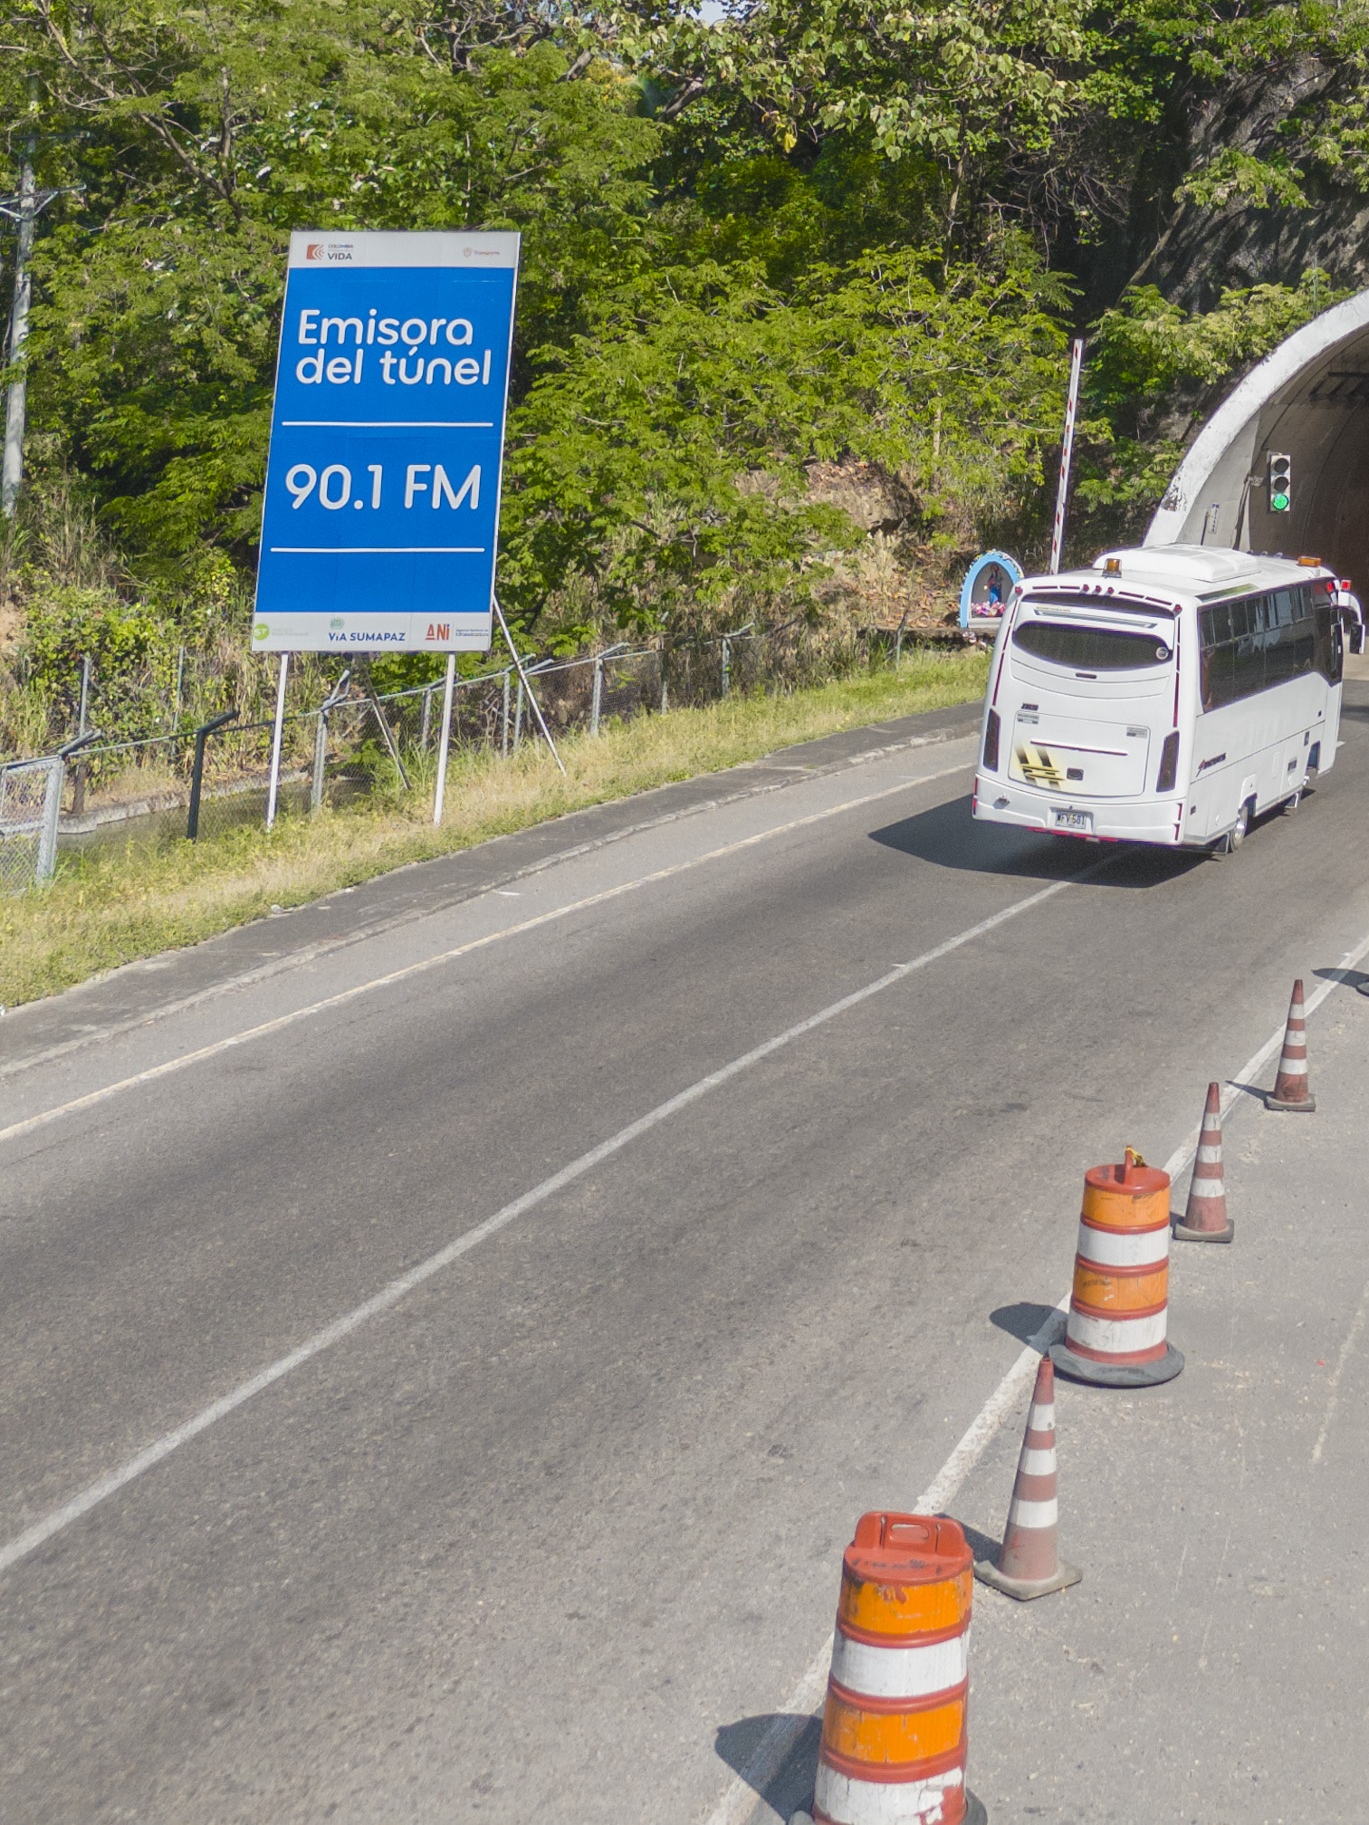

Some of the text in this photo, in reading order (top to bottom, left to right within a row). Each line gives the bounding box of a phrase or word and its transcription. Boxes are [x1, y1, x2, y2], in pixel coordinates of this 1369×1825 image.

[327, 252, 353, 260] VIDA
[298, 309, 474, 346] Emisora
[296, 347, 492, 386] del túnel
[285, 464, 482, 510] 90.1 FM
[350, 632, 406, 641] SUMAPAZ
